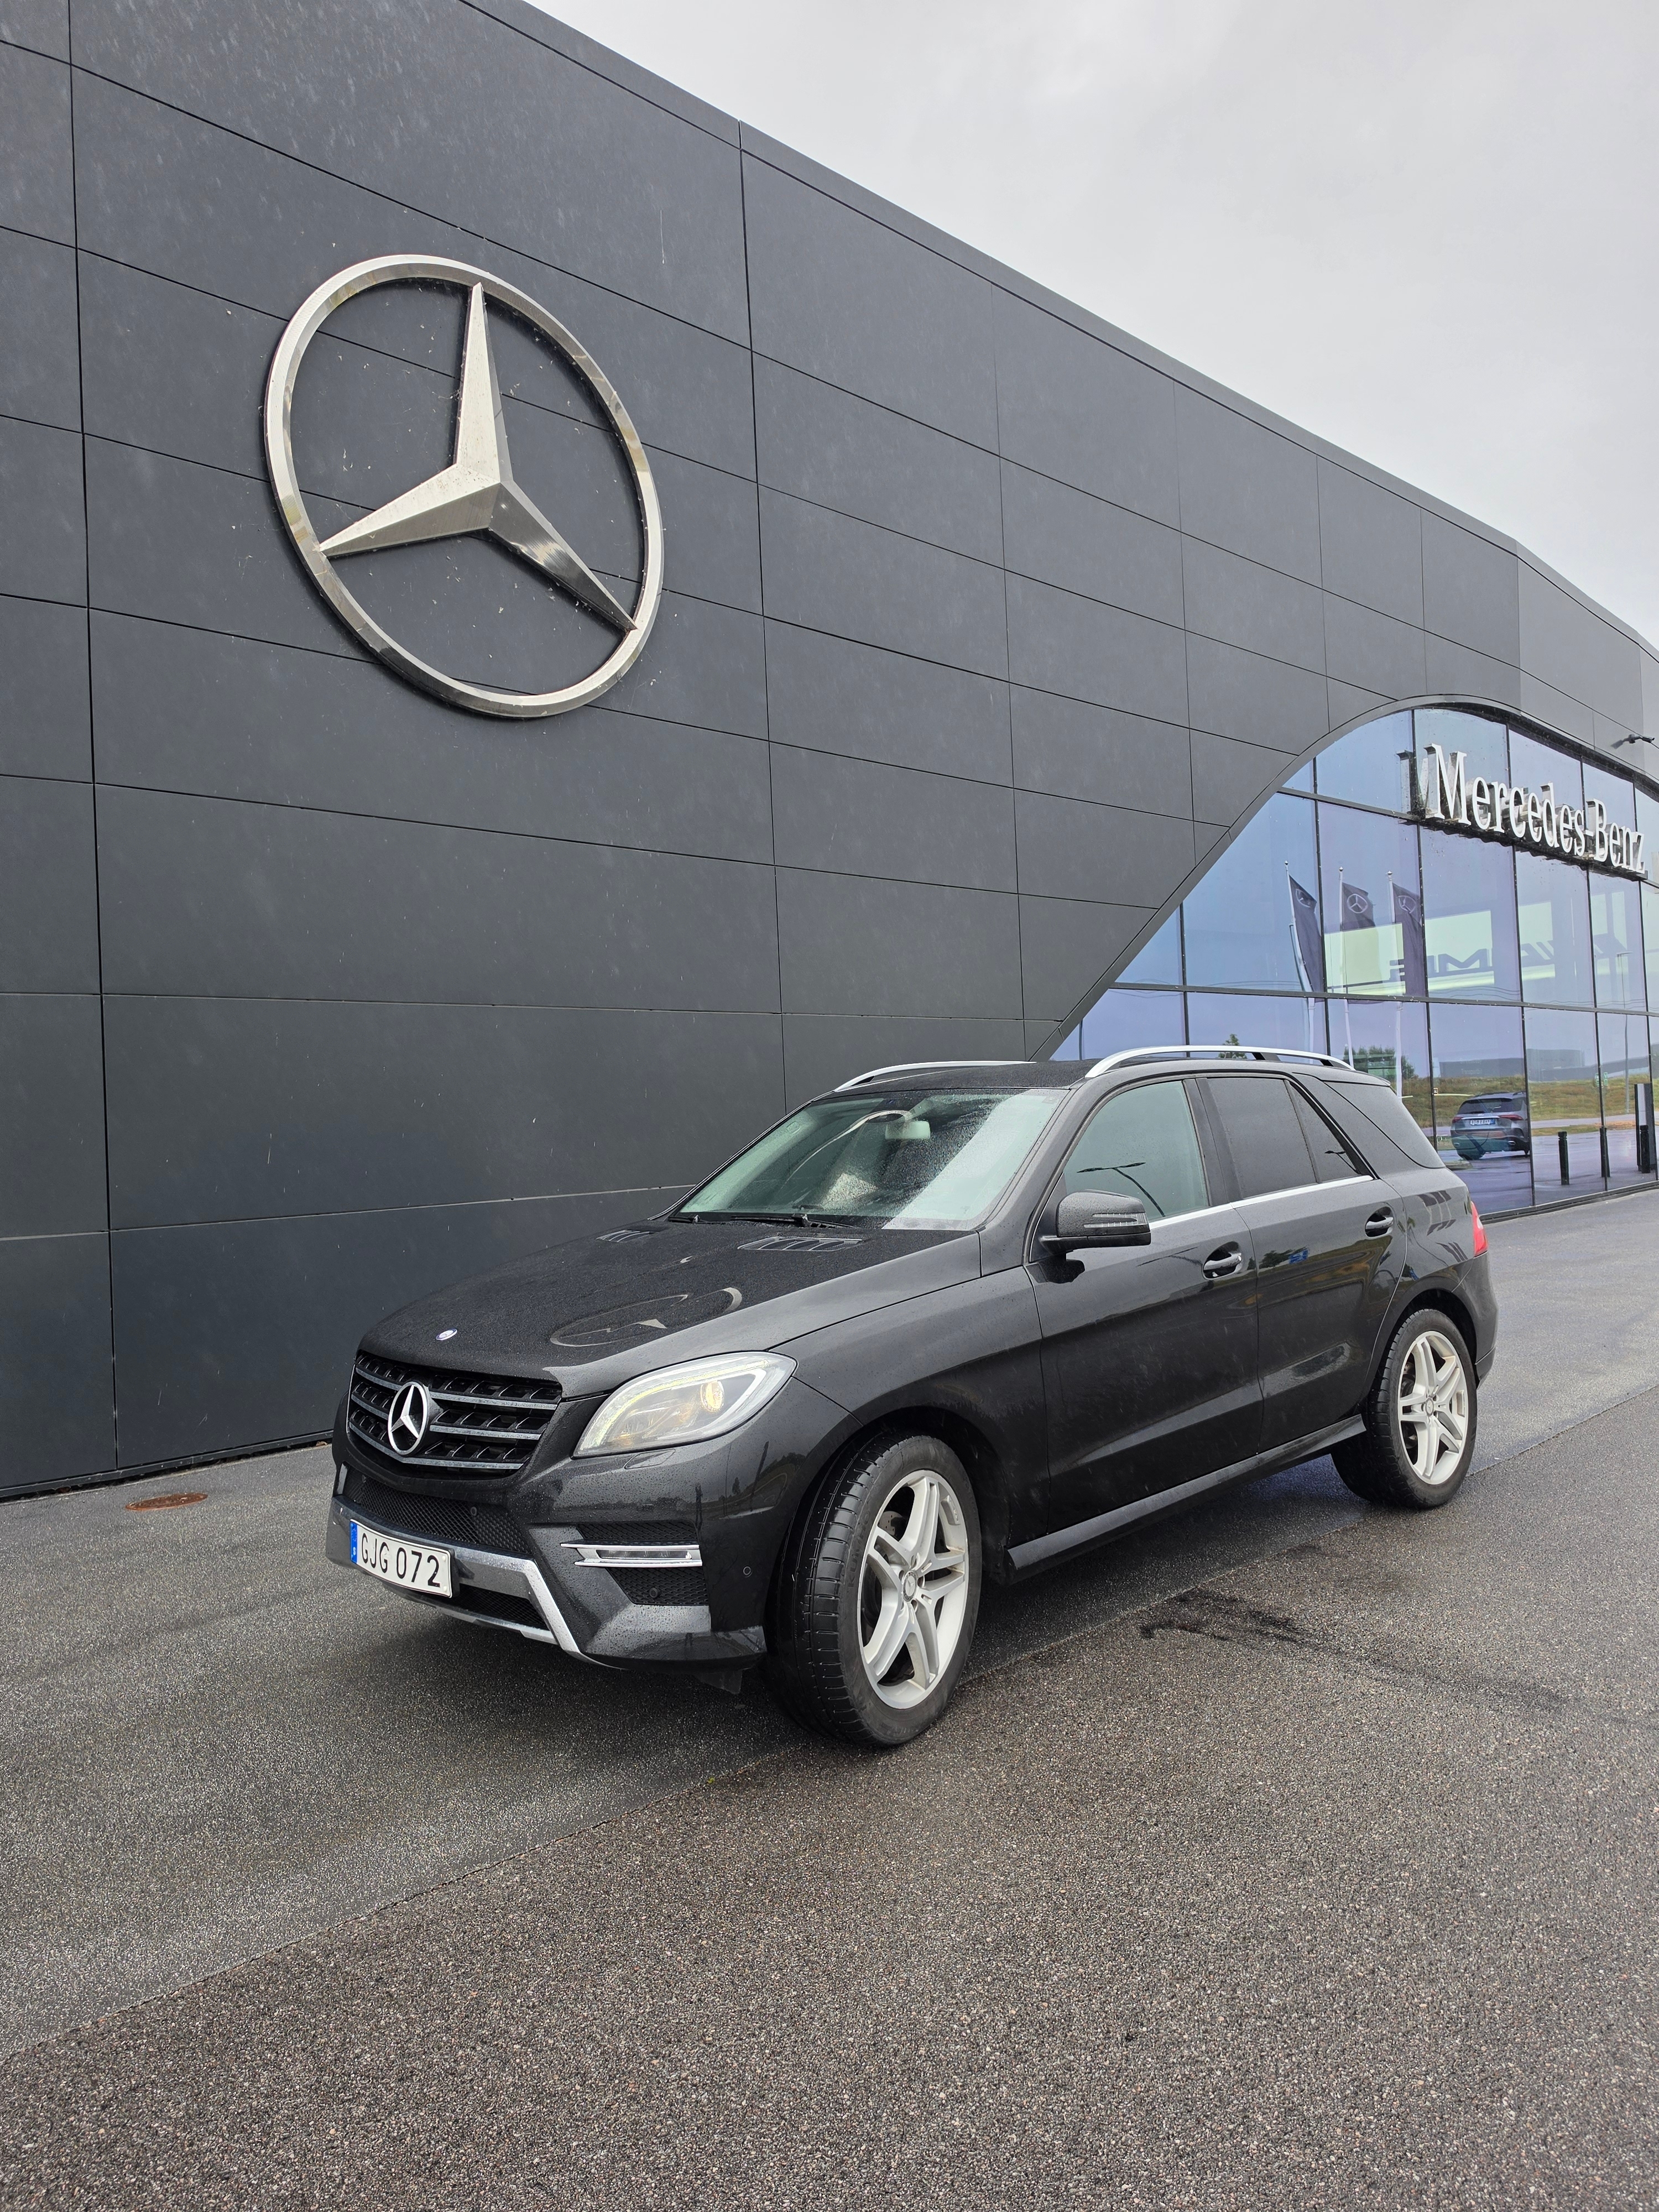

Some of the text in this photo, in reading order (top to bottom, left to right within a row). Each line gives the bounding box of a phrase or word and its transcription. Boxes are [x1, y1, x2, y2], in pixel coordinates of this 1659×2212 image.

[1427, 743, 1645, 874] Mercedes-Benz
[353, 1546, 356, 1556] S
[361, 1532, 440, 1588] GJG 072
